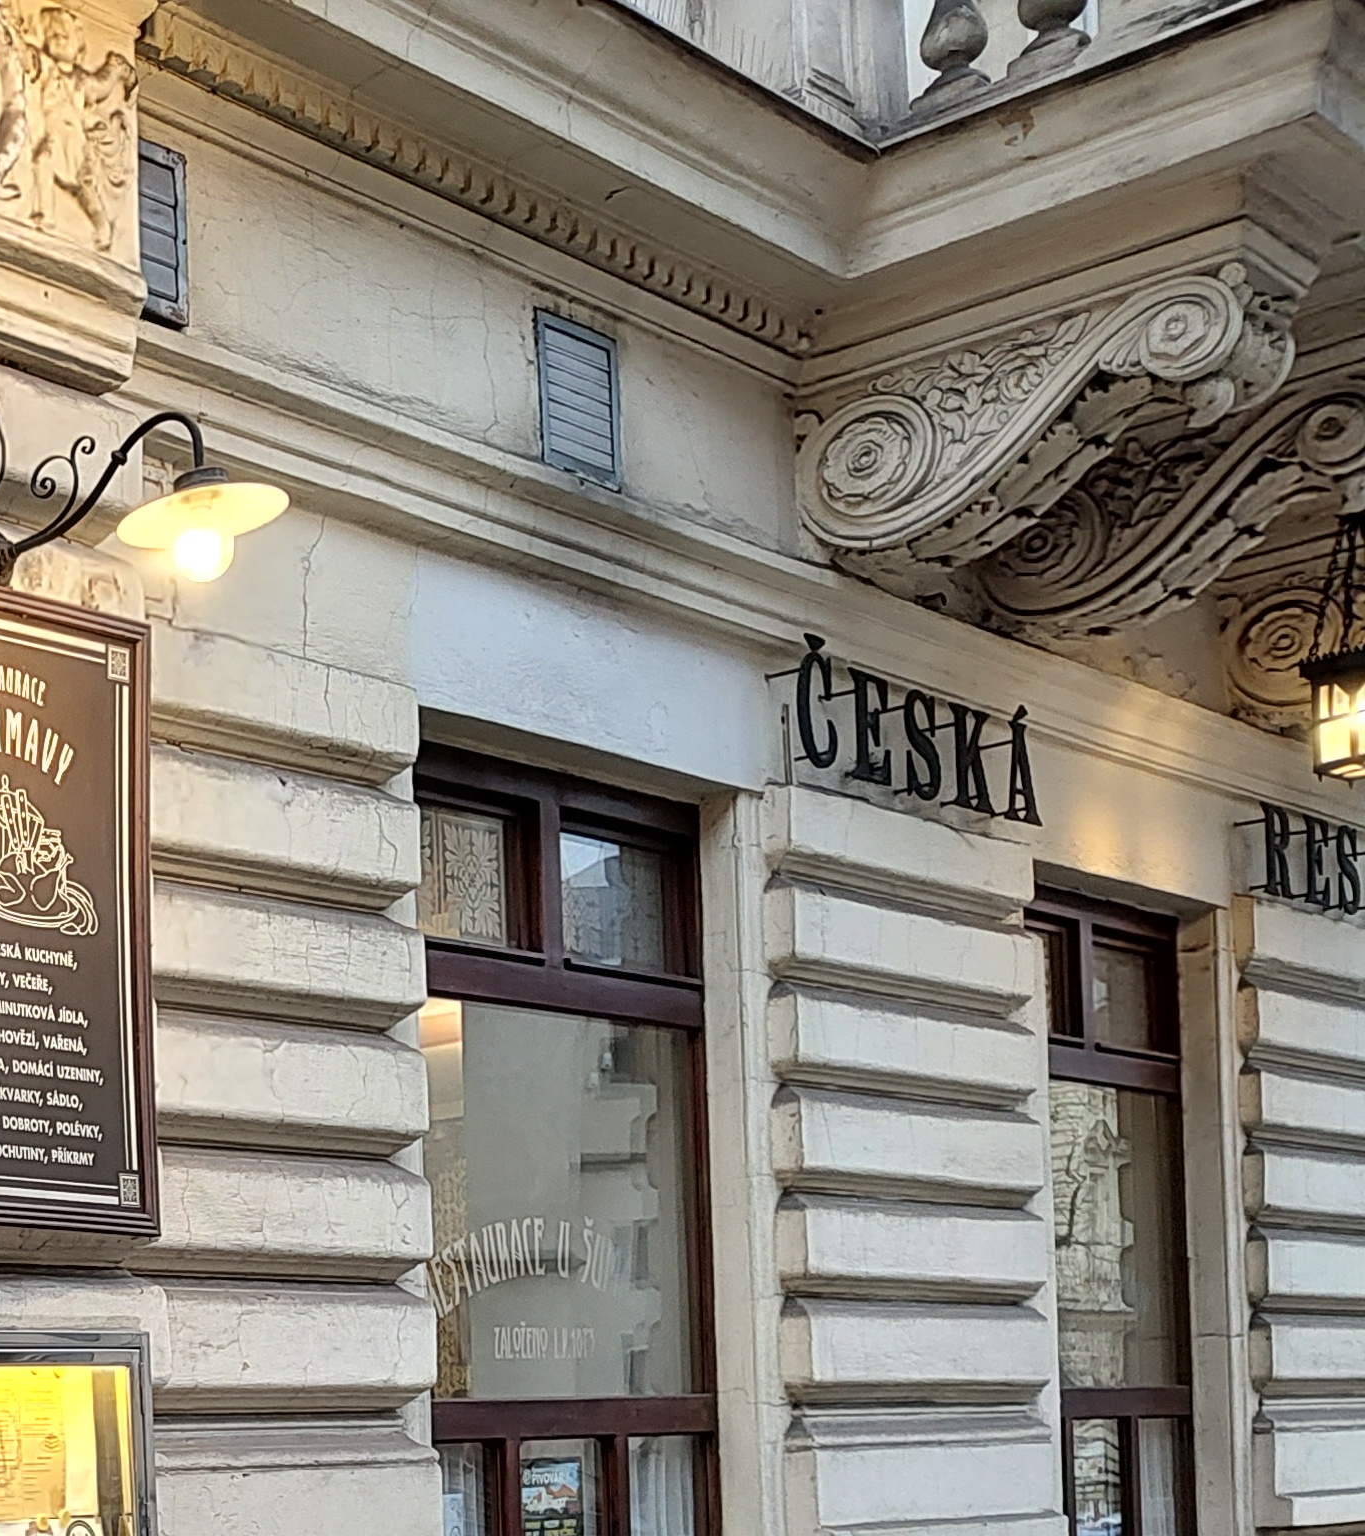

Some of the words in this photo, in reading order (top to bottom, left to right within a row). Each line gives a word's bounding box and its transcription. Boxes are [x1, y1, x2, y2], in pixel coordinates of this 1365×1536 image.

[796, 633, 1042, 826] ČESKÁ
[1260, 801, 1361, 915] RES
[25, 947, 77, 970] KUCHYNĚ,
[12, 974, 53, 995] VEČEŘE,
[58, 1009, 88, 1028] JÍDLA,
[43, 1034, 87, 1055] VAŘENÁ,
[13, 1060, 53, 1077] DOMÁCÍ
[57, 1066, 104, 1086] UZENINY,
[46, 1089, 83, 1111] SÁDLO,
[3, 1116, 53, 1137] DOBROTY,
[56, 1120, 103, 1141] POLÉVKY,
[51, 1147, 94, 1166] PŘÍKRMY
[558, 1220, 570, 1278] U
